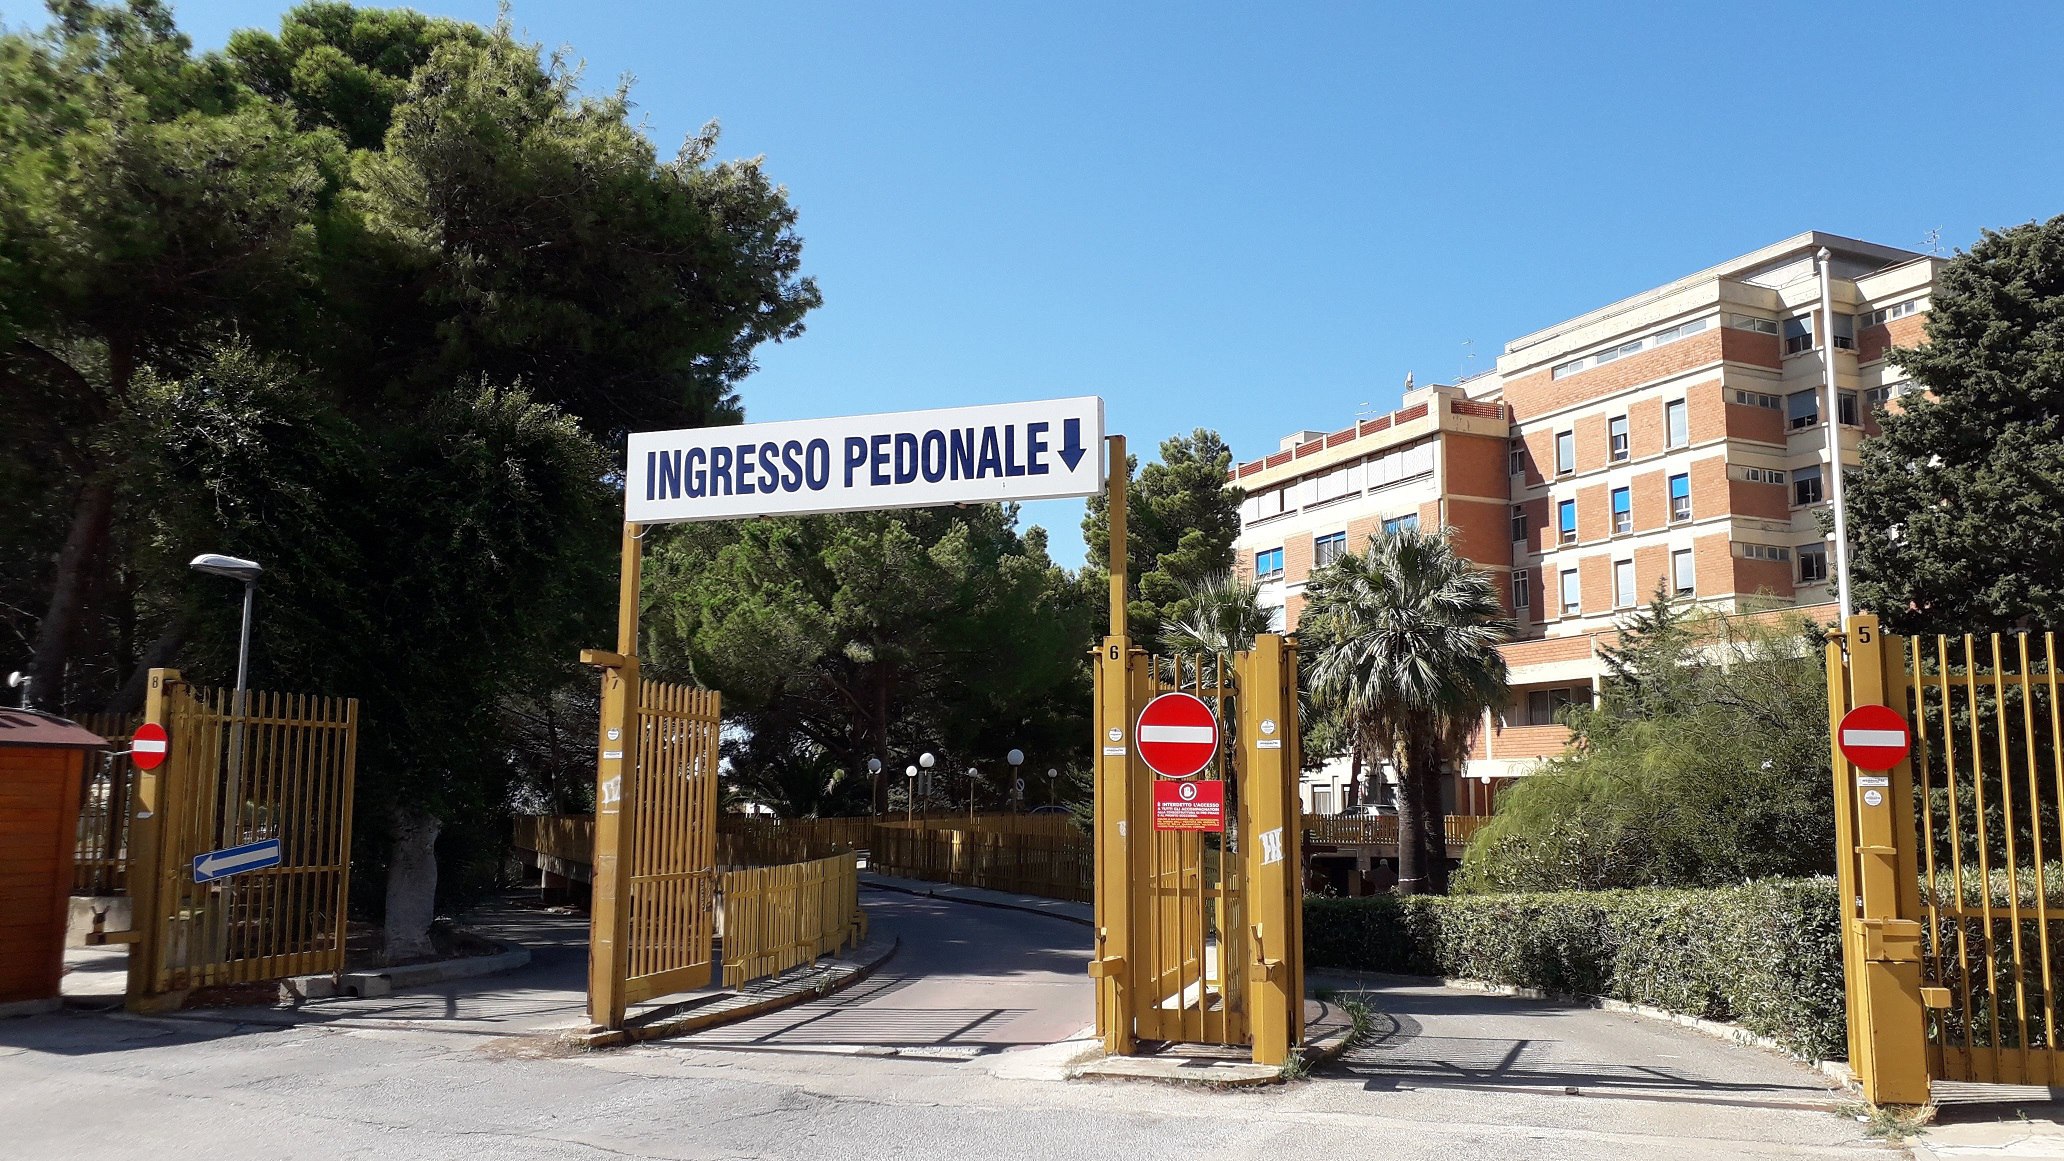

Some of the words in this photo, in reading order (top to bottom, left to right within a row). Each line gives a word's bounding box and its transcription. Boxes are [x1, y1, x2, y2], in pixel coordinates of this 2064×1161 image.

[647, 439, 829, 500] INGRESSO
[845, 422, 1049, 487] PEDONALE
[1858, 626, 1871, 644] 5
[1109, 646, 1119, 660] 6
[152, 676, 159, 689] 8
